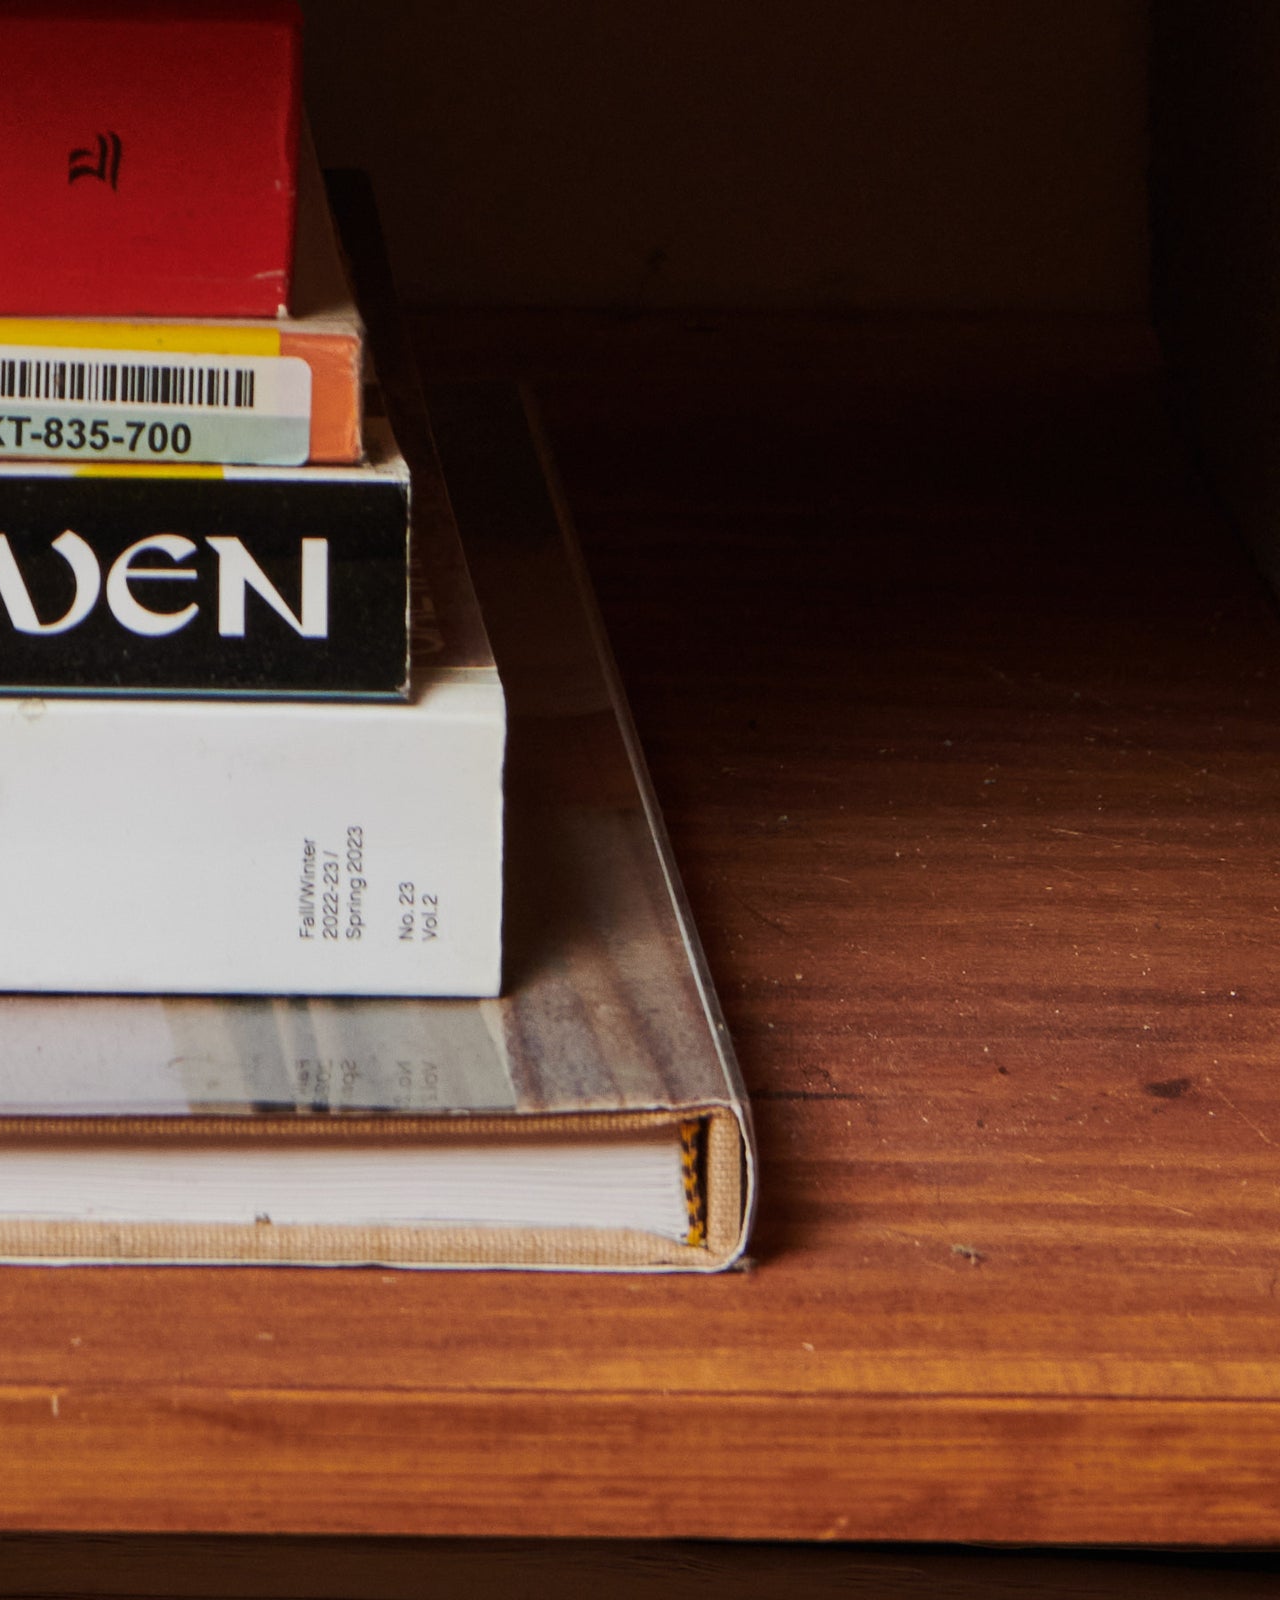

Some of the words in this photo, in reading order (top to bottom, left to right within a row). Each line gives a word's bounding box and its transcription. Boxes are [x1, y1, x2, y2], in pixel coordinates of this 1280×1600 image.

[346, 824, 364, 874] 2023
[299, 837, 317, 940] Fall/Winter
[322, 861, 340, 941] 2022-23
[345, 877, 367, 941] Spring
[398, 880, 416, 906] 23
[398, 909, 415, 942] No.
